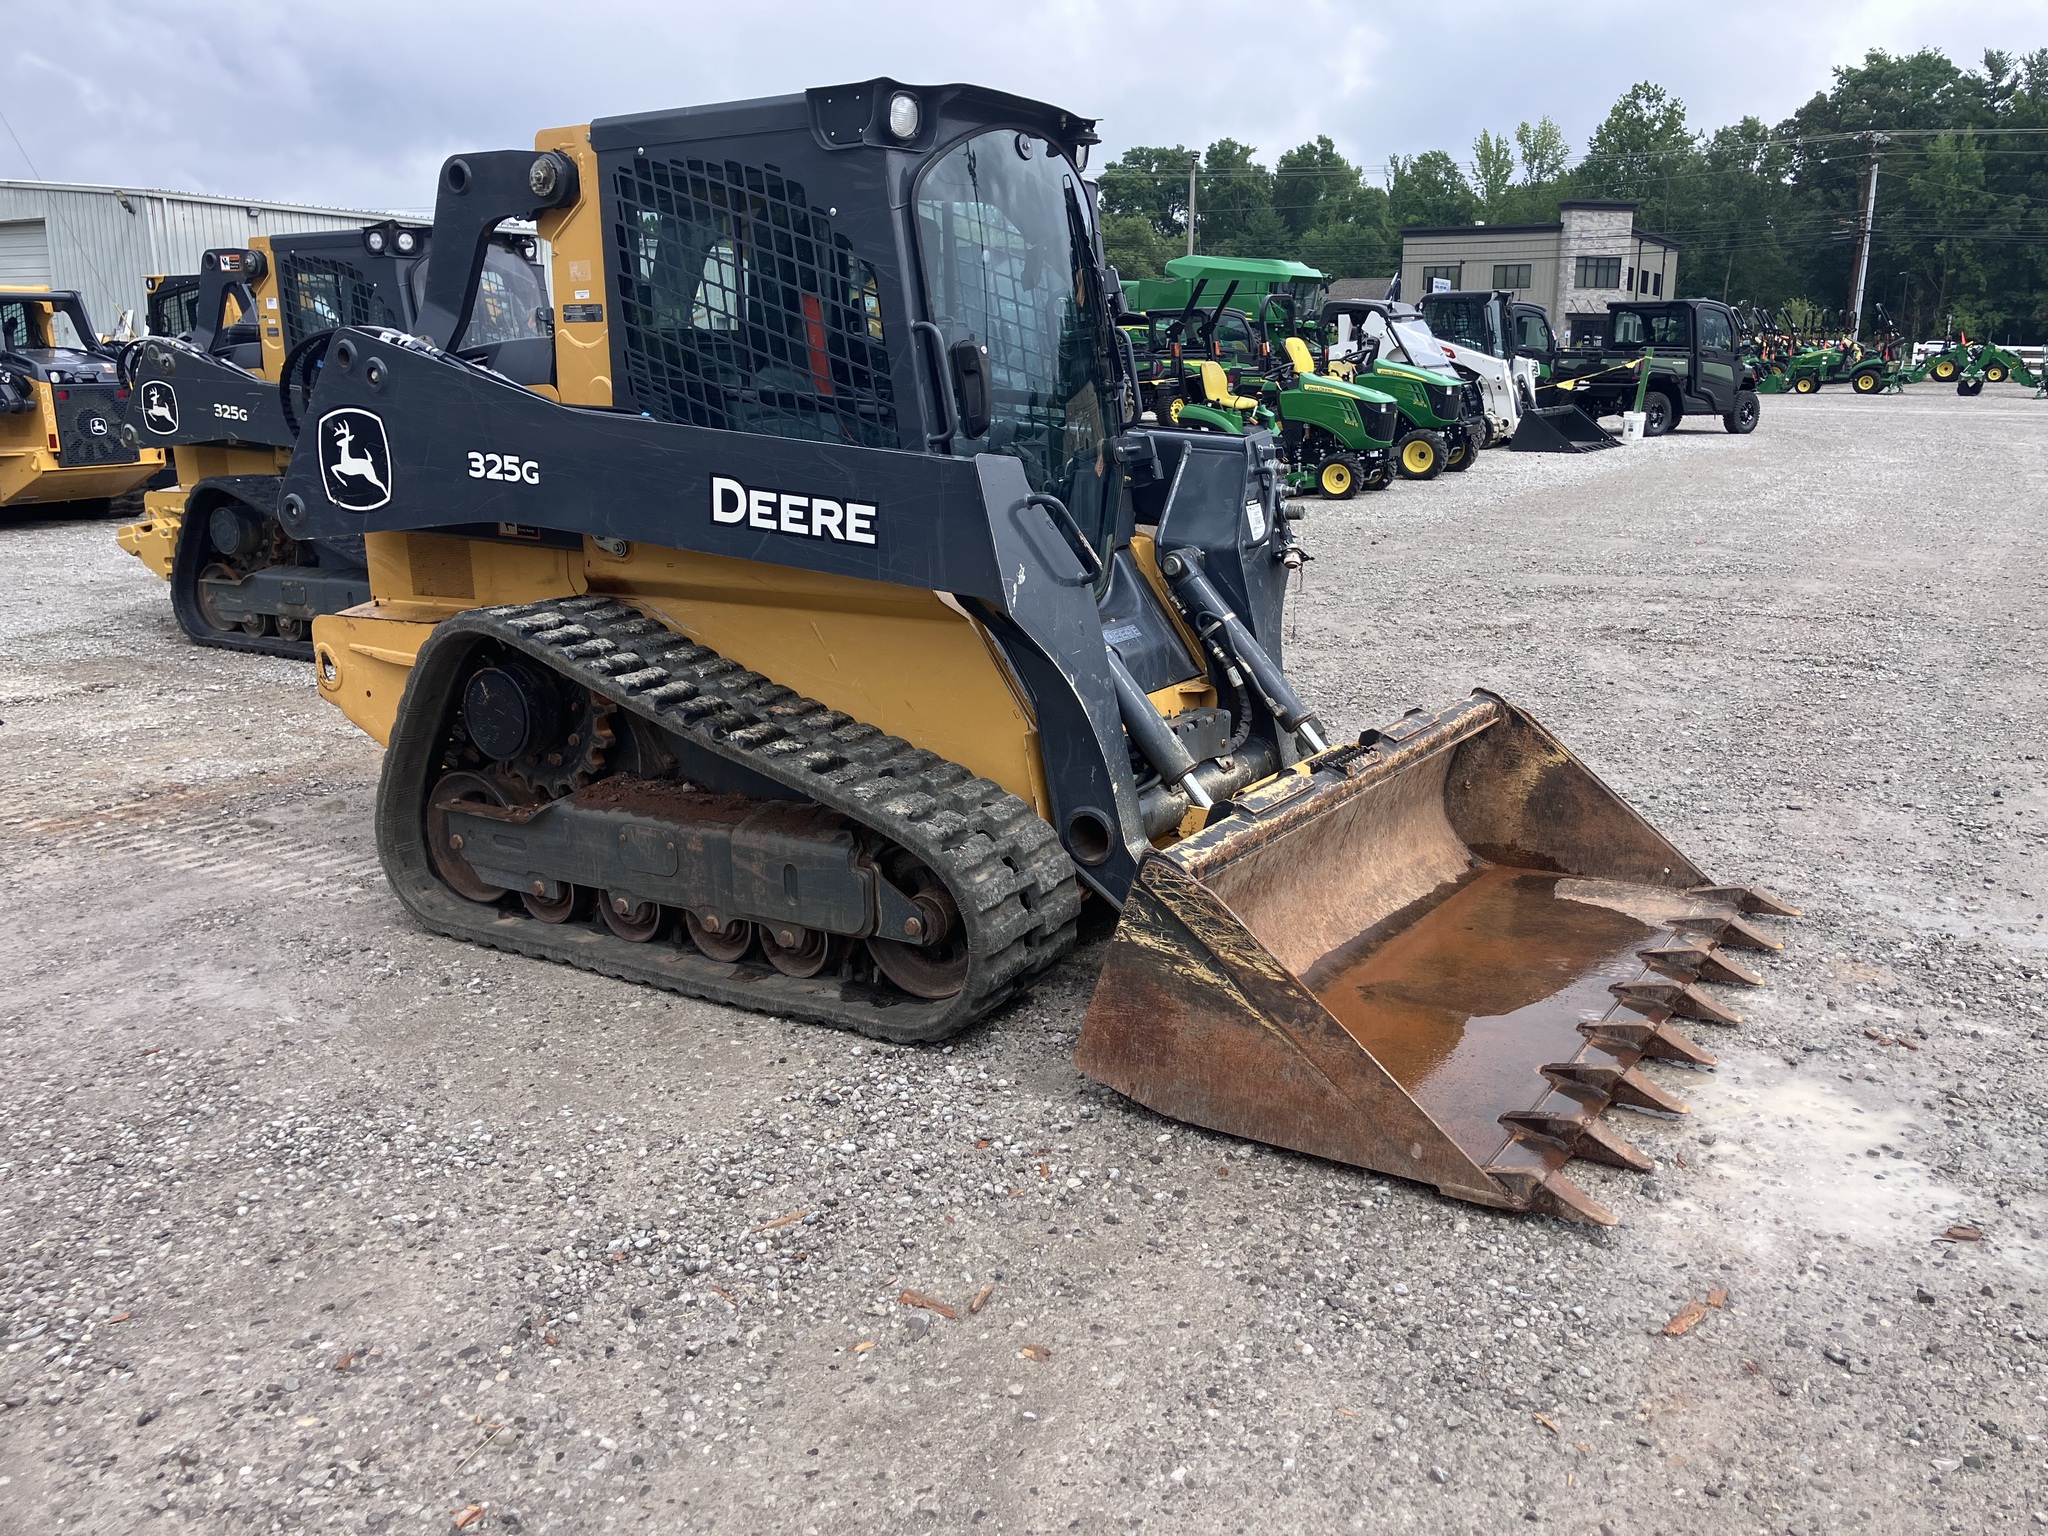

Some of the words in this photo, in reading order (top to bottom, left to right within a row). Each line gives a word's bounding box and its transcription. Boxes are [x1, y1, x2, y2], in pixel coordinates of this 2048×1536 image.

[213, 403, 248, 422] 325G
[467, 451, 540, 485] 325G
[712, 476, 876, 545] DEERE
[1106, 625, 1141, 643] DEERE
